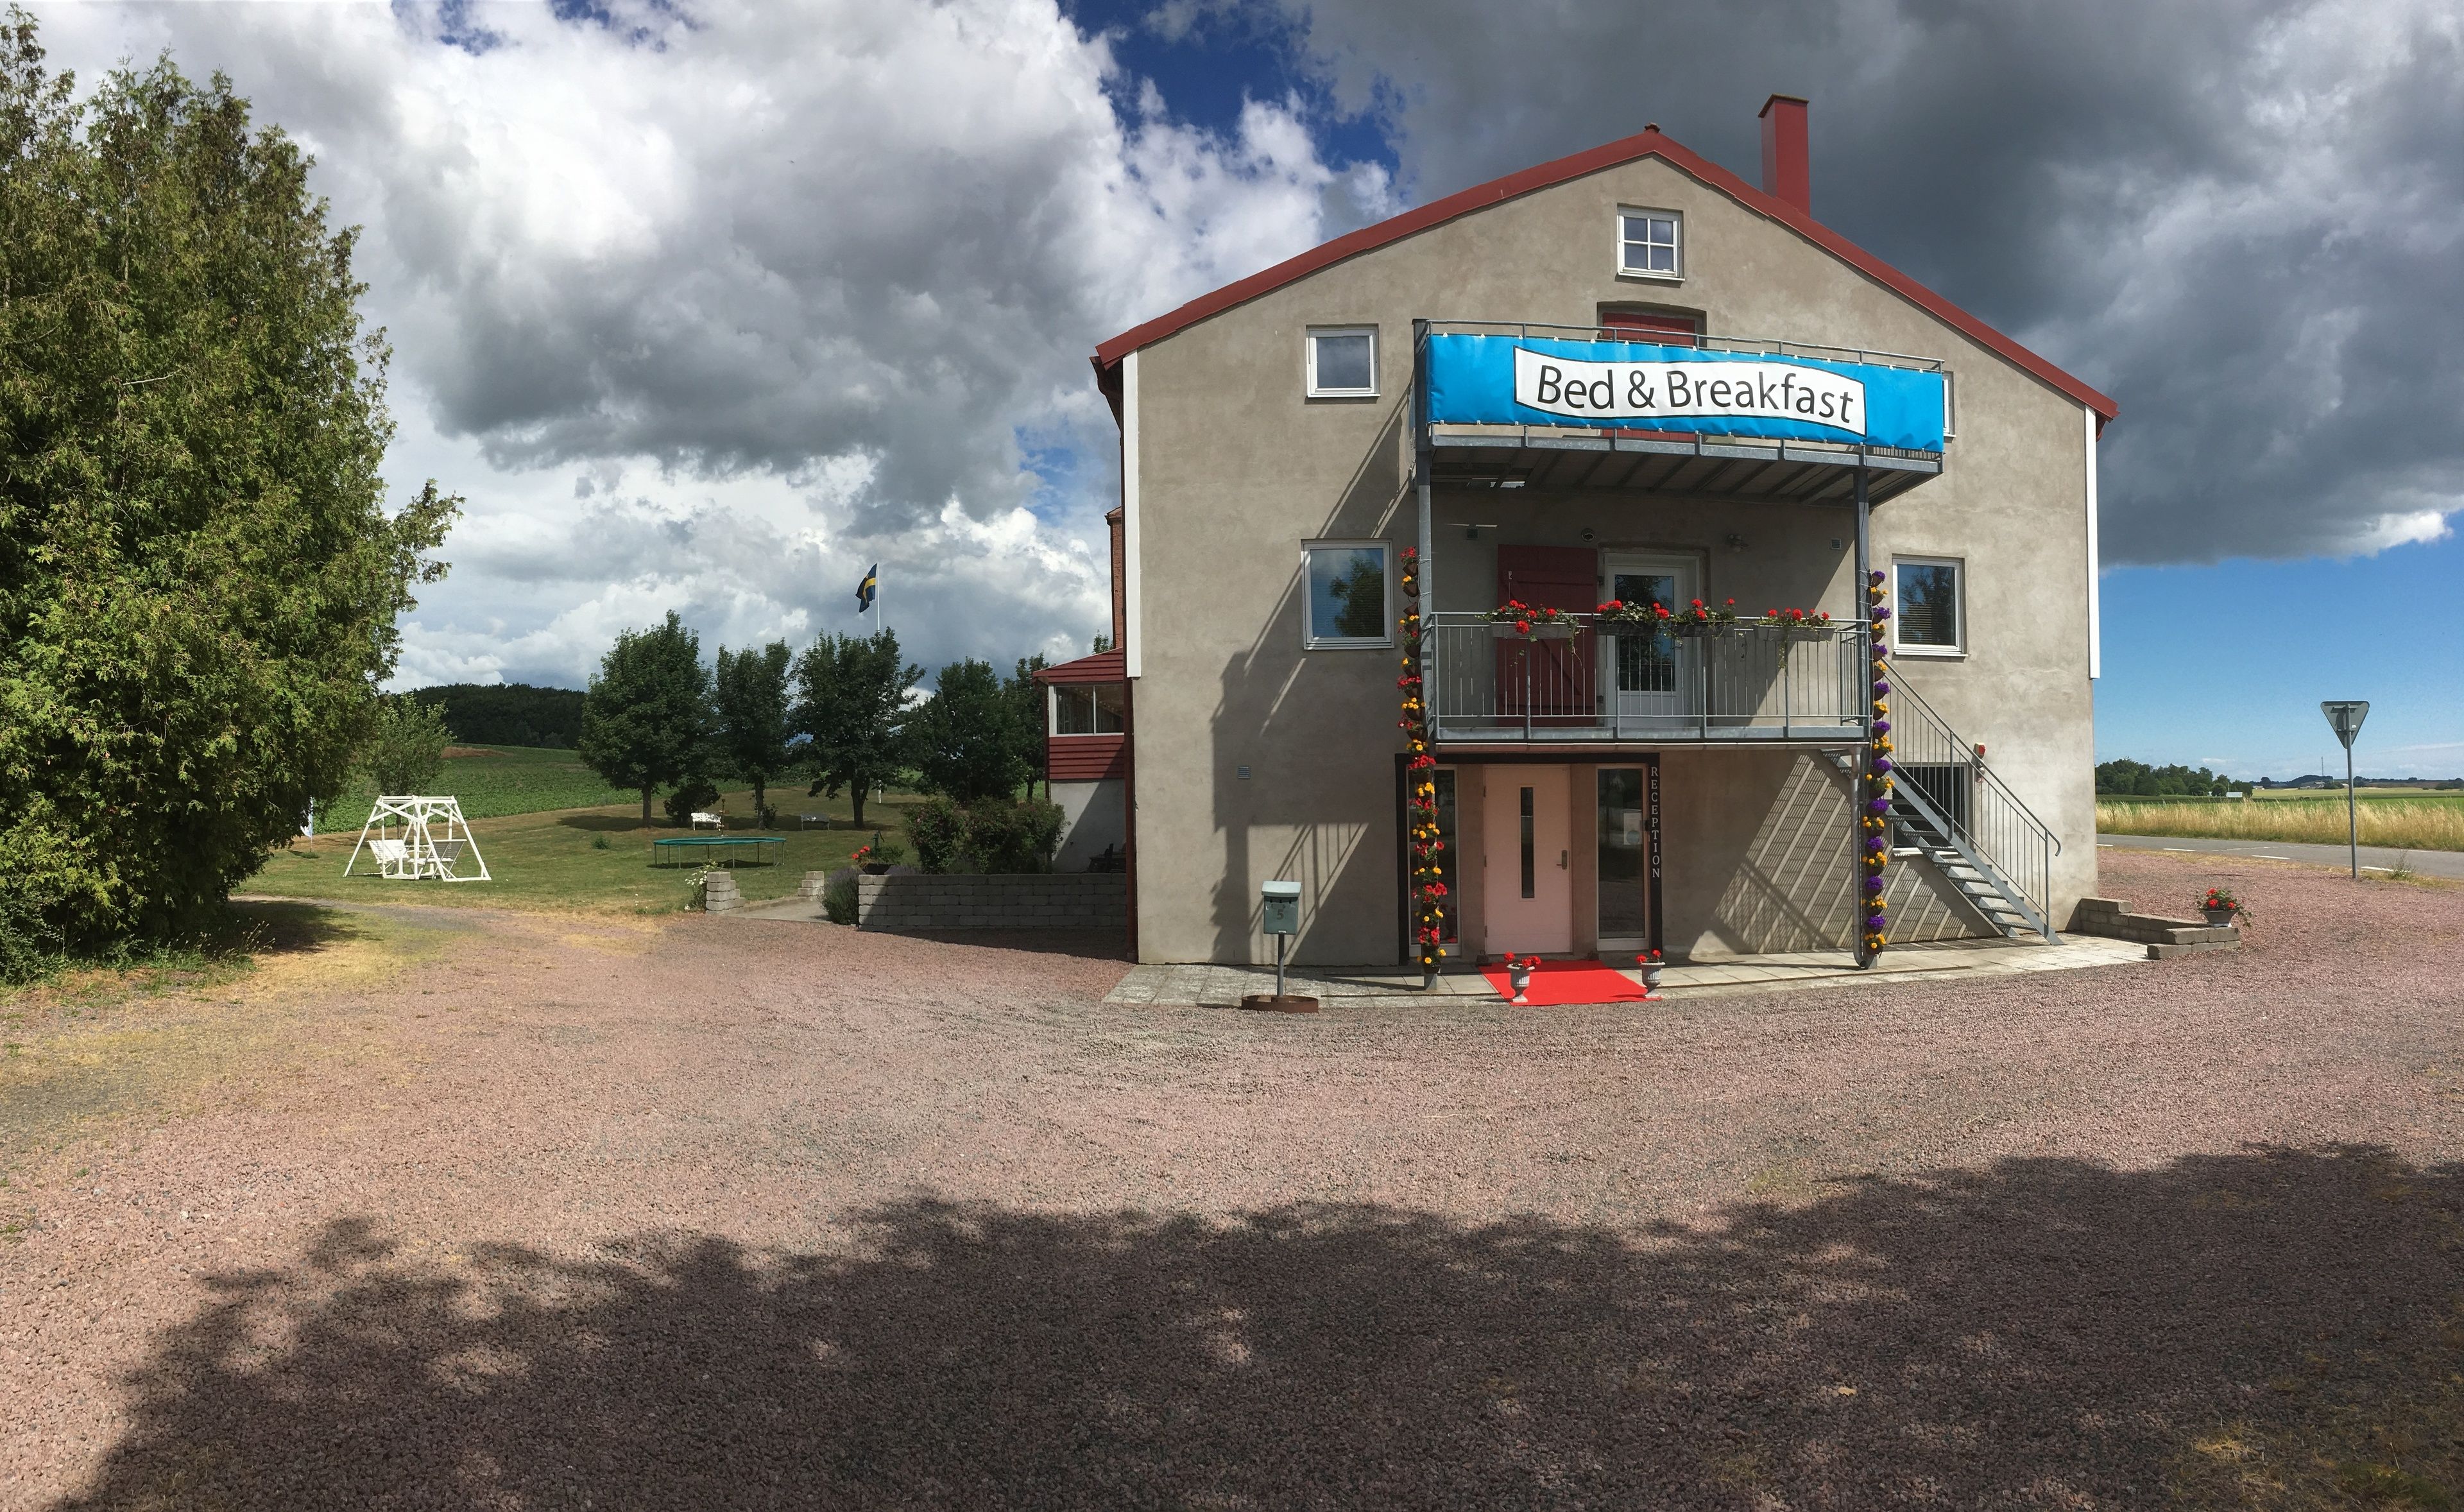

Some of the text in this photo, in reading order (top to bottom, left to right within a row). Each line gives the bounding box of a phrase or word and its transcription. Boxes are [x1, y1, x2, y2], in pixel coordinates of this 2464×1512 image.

[1537, 365, 1854, 424] Bed & Breakfast
[1650, 766, 1661, 879] RECEPTION
